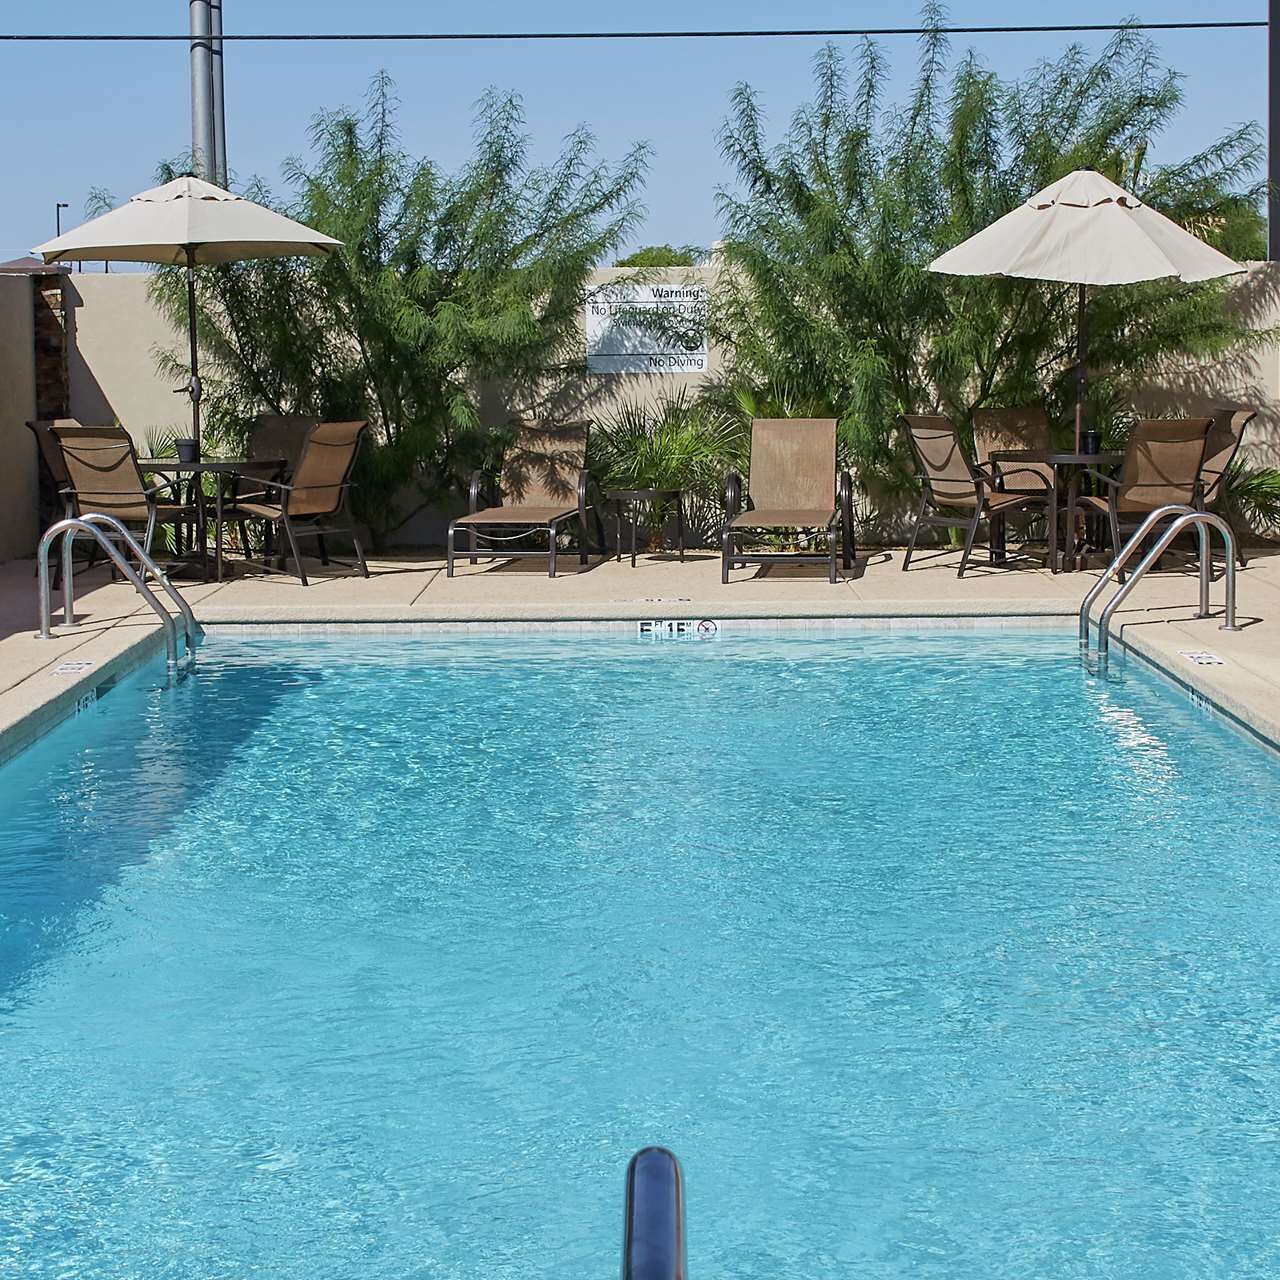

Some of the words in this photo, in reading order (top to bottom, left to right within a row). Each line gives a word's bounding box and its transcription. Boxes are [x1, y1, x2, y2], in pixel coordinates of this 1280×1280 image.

[651, 287, 703, 300] Warning:
[591, 305, 607, 316] No
[609, 303, 659, 318] Lifeguard
[662, 306, 675, 316] on
[649, 356, 665, 367] No
[668, 355, 704, 369] Diving
